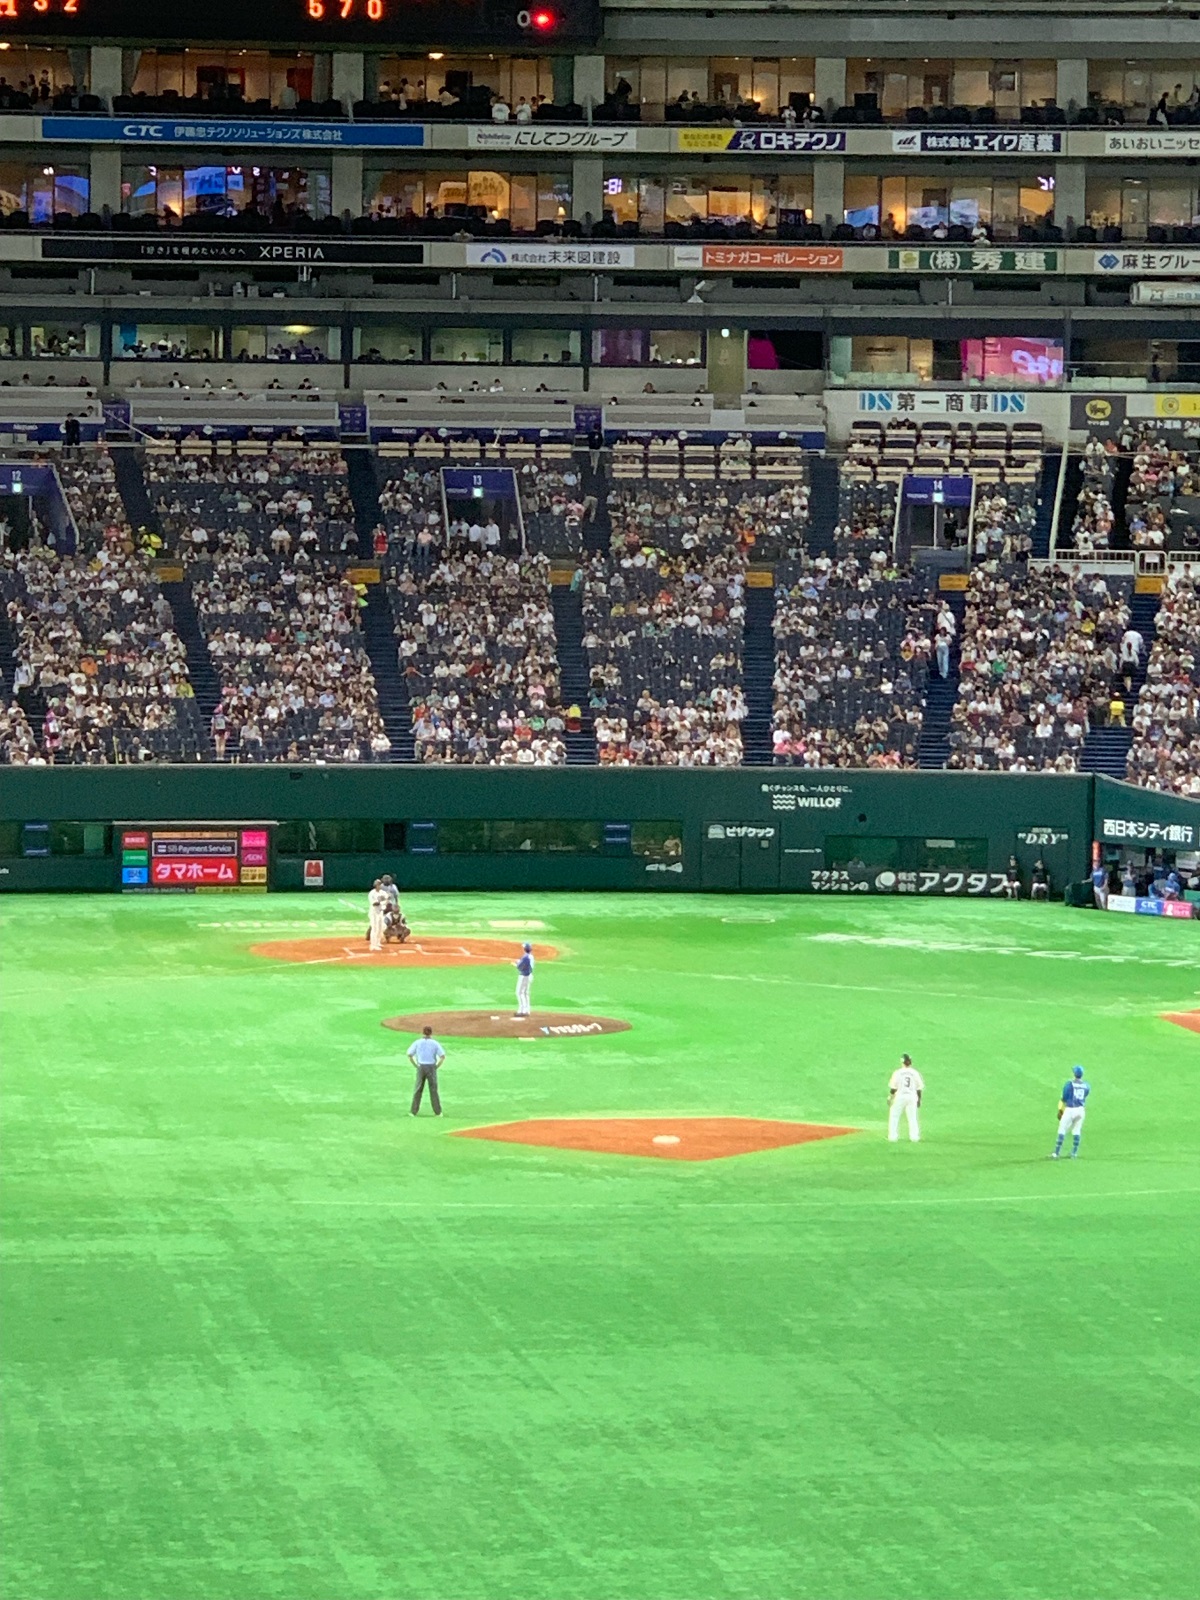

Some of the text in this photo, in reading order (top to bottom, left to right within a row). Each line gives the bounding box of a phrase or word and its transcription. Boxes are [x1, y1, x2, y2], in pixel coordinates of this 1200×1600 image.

[339, 0, 353, 18] 7
[368, 0, 382, 19] 0
[123, 125, 163, 137] CTC
[514, 131, 629, 147] にしてつグループ
[760, 132, 841, 150] ロキテクノ
[1109, 137, 1200, 150] あいおいニッセ
[259, 246, 325, 259] XPERIA
[705, 251, 840, 265] トミナガコーポレーション
[897, 392, 989, 412] 第一商事
[12, 470, 21, 481] 12
[473, 475, 482, 486] 13
[933, 480, 943, 491] 14
[797, 796, 841, 808] WILLOF
[726, 826, 775, 838] ピザクック
[1103, 819, 1193, 843] 西日本シティ銀行
[178, 844, 207, 854] Payment
[208, 844, 232, 853] Service
[156, 862, 234, 880] タマホーム
[811, 870, 849, 880] アクタス
[811, 881, 869, 891] マンションの
[904, 1076, 911, 1088] 3
